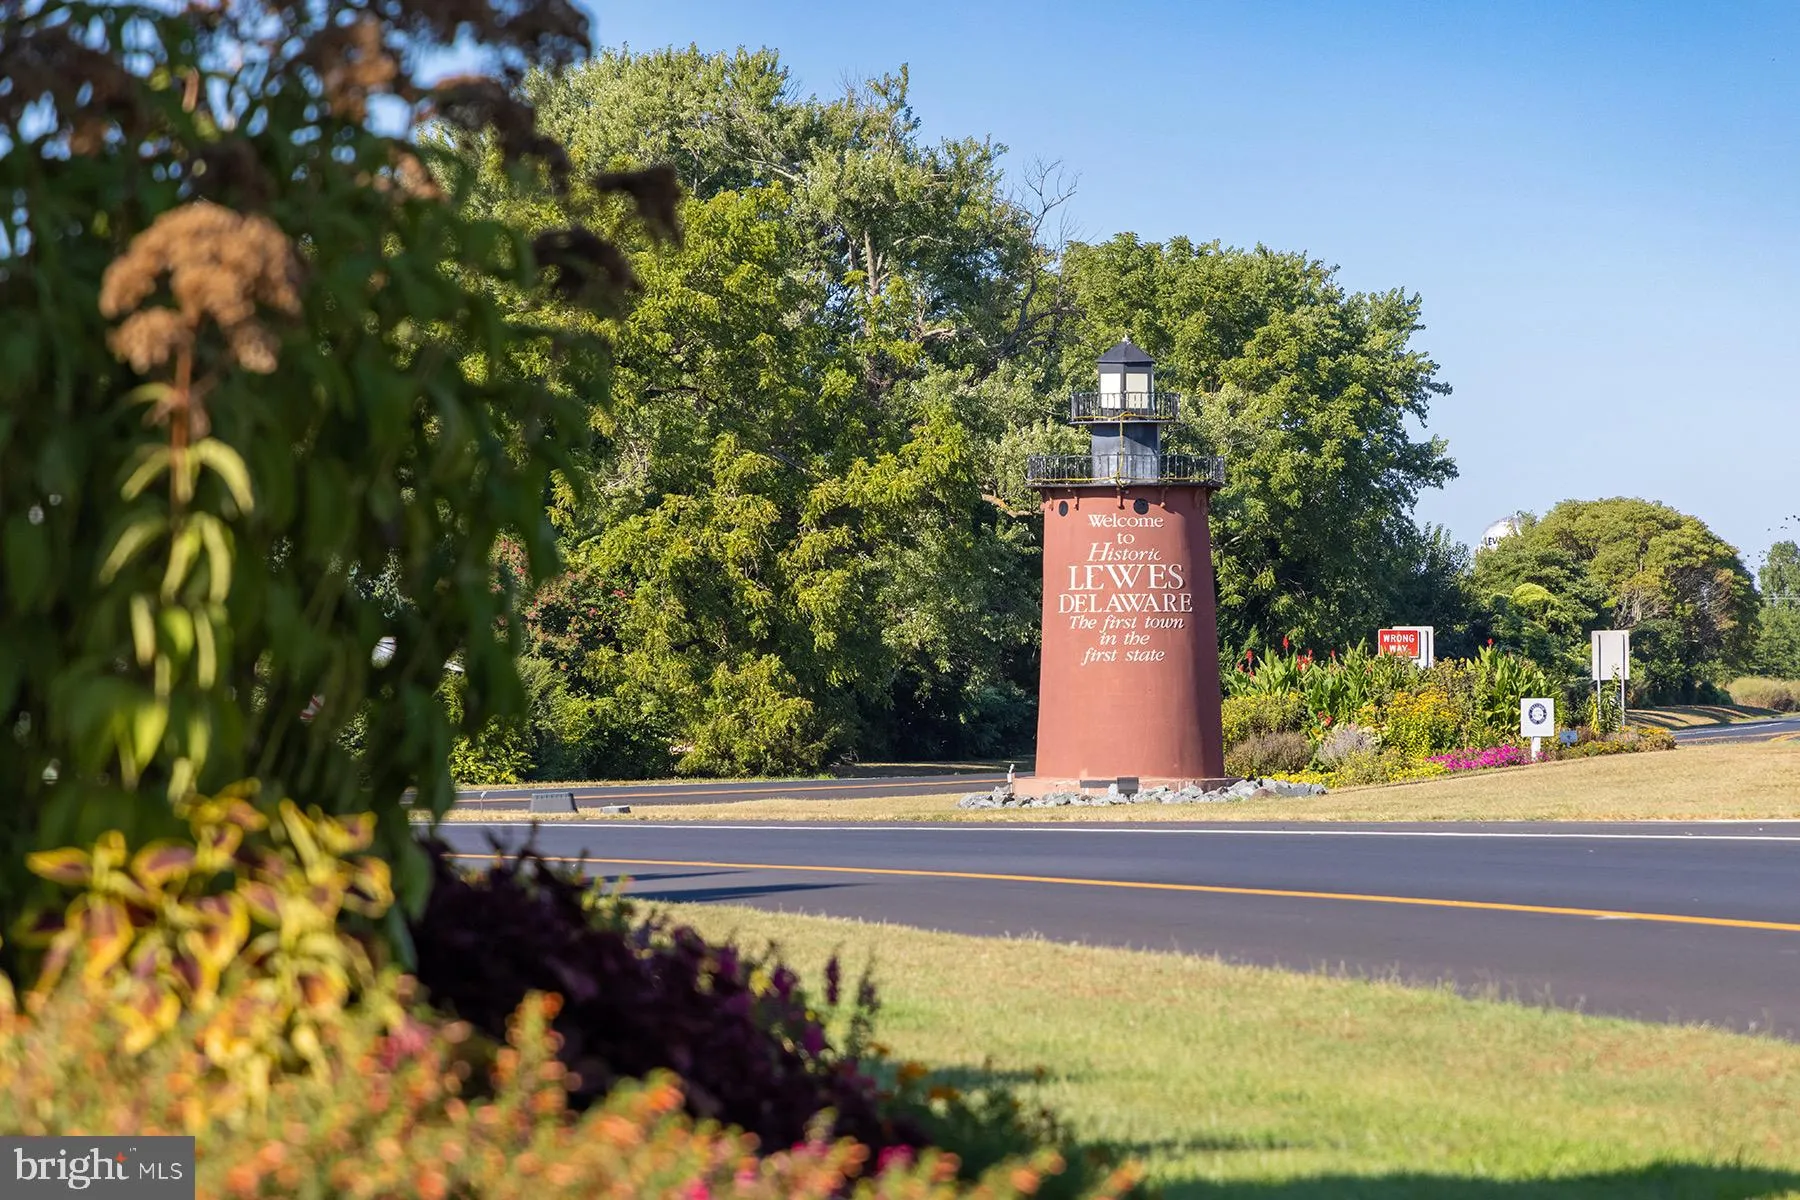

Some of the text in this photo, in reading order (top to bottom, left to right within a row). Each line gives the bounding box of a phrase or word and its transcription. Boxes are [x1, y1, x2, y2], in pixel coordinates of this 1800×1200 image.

[1088, 513, 1164, 528] Welcome
[1117, 533, 1135, 544] to
[1087, 542, 1162, 562] Historic
[1068, 564, 1185, 591] LEWES
[1058, 593, 1193, 613] DELAWARE
[1070, 615, 1184, 632] The first town
[1099, 631, 1150, 645] in the
[1383, 634, 1415, 643] WRONG
[1081, 648, 1165, 665] first state
